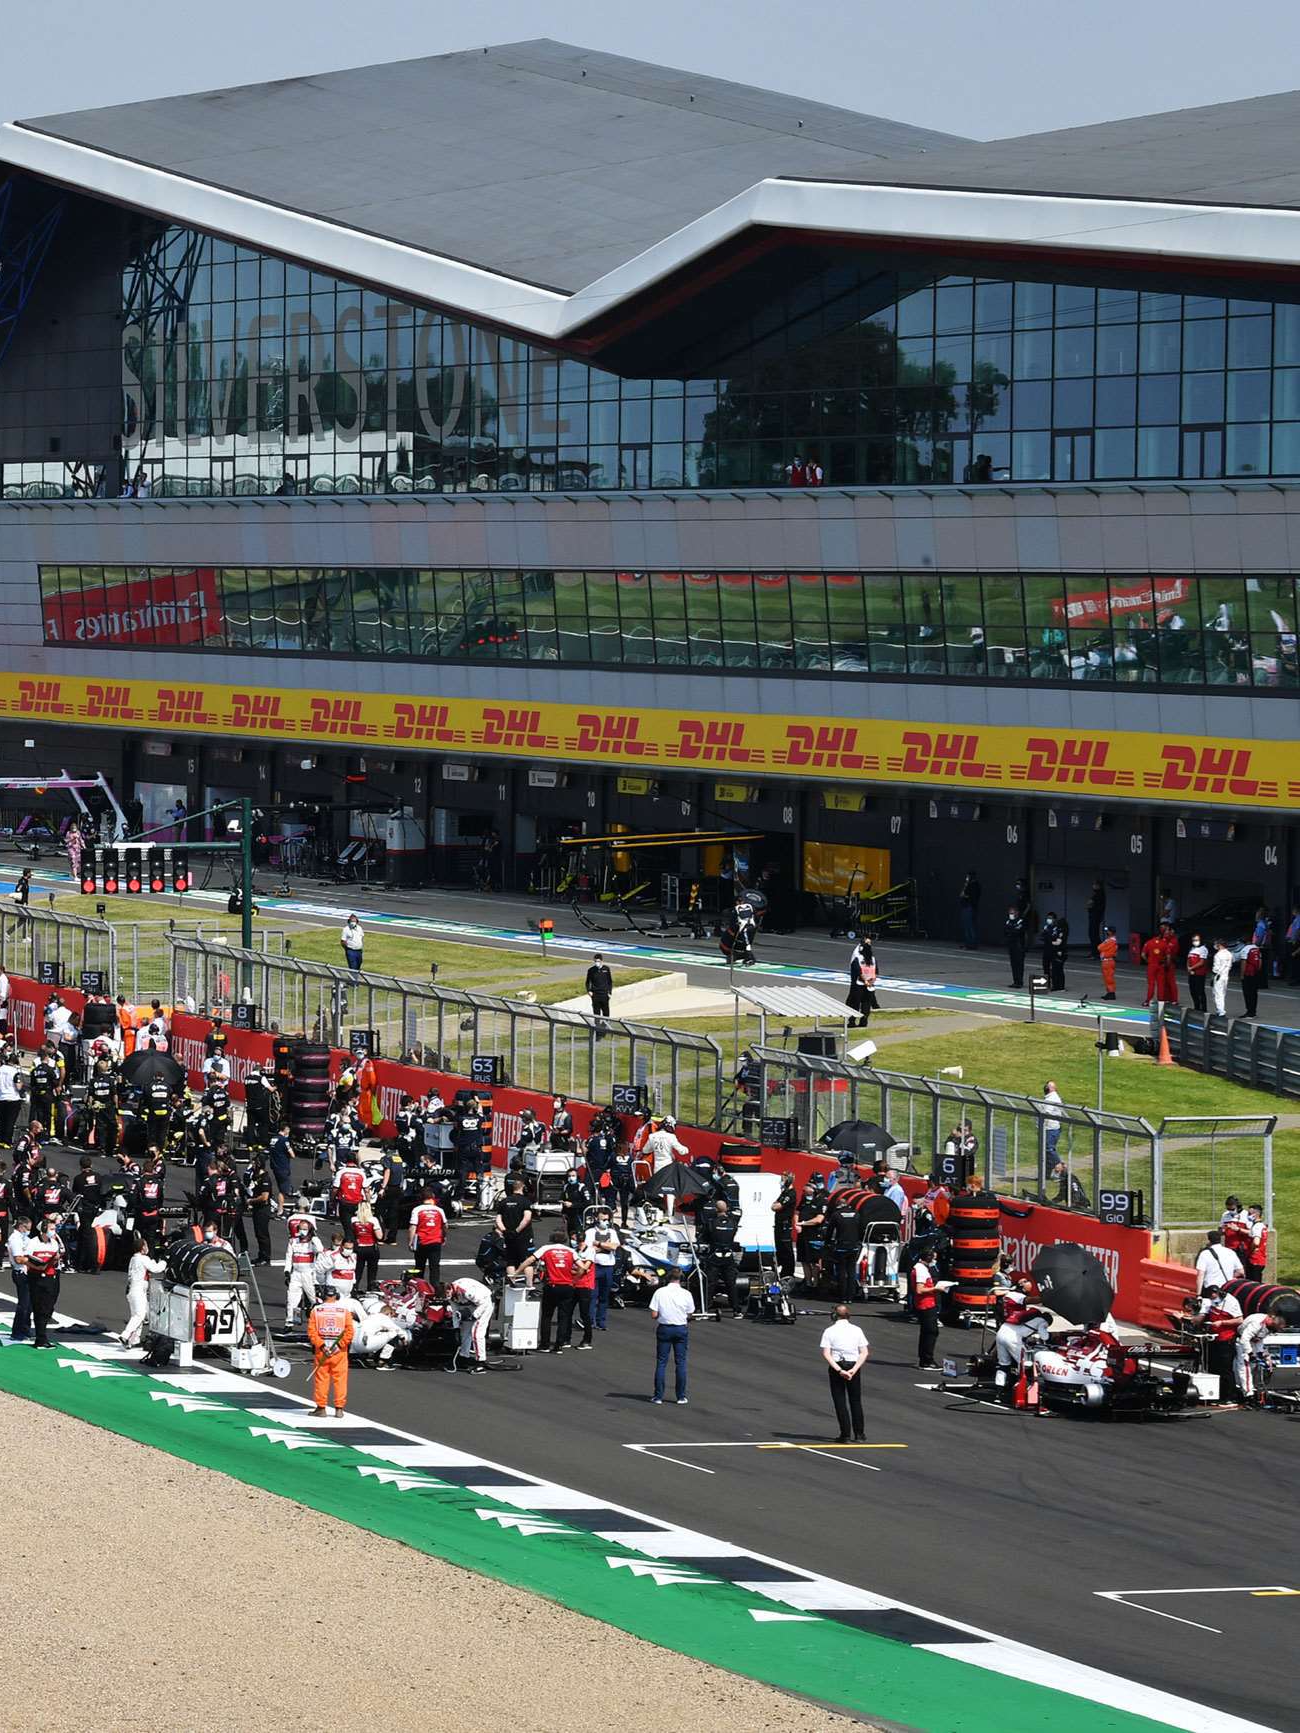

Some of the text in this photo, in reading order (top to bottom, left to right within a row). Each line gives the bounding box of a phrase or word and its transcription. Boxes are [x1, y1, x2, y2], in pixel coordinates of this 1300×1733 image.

[121, 305, 570, 450] SILVERSTONE
[18, 681, 64, 714] DHL
[85, 685, 134, 719] DHL
[156, 689, 209, 724] DHL
[232, 694, 286, 730] DHL
[311, 698, 368, 736] DHL
[394, 703, 454, 742] DHL
[482, 708, 547, 748] DHL
[577, 714, 646, 755] DHL
[678, 719, 751, 763] DHL
[786, 725, 865, 769] DHL
[902, 731, 986, 778] DHL
[1026, 738, 1116, 785] DHL
[1160, 744, 1259, 796] DHL
[414, 777, 422, 793] 12
[499, 784, 506, 800] 11
[587, 791, 596, 807] 10
[783, 807, 793, 824] 08
[891, 816, 902, 834] 07
[1006, 825, 1018, 843] 06
[1130, 835, 1143, 853] 05
[1264, 845, 1278, 865] 04
[43, 963, 52, 976] 5
[82, 973, 99, 986] 55
[237, 1006, 248, 1018] 8
[352, 1033, 369, 1046] 31
[472, 1058, 493, 1072] 63
[474, 1074, 491, 1083] RUS
[614, 1088, 637, 1103] 26
[763, 1119, 787, 1136] 20
[942, 1157, 955, 1174] 6
[939, 1176, 960, 1185] LAT
[1101, 1193, 1129, 1211] 99
[1106, 1213, 1125, 1224] GIO
[1042, 1366, 1069, 1377] ORLEN
